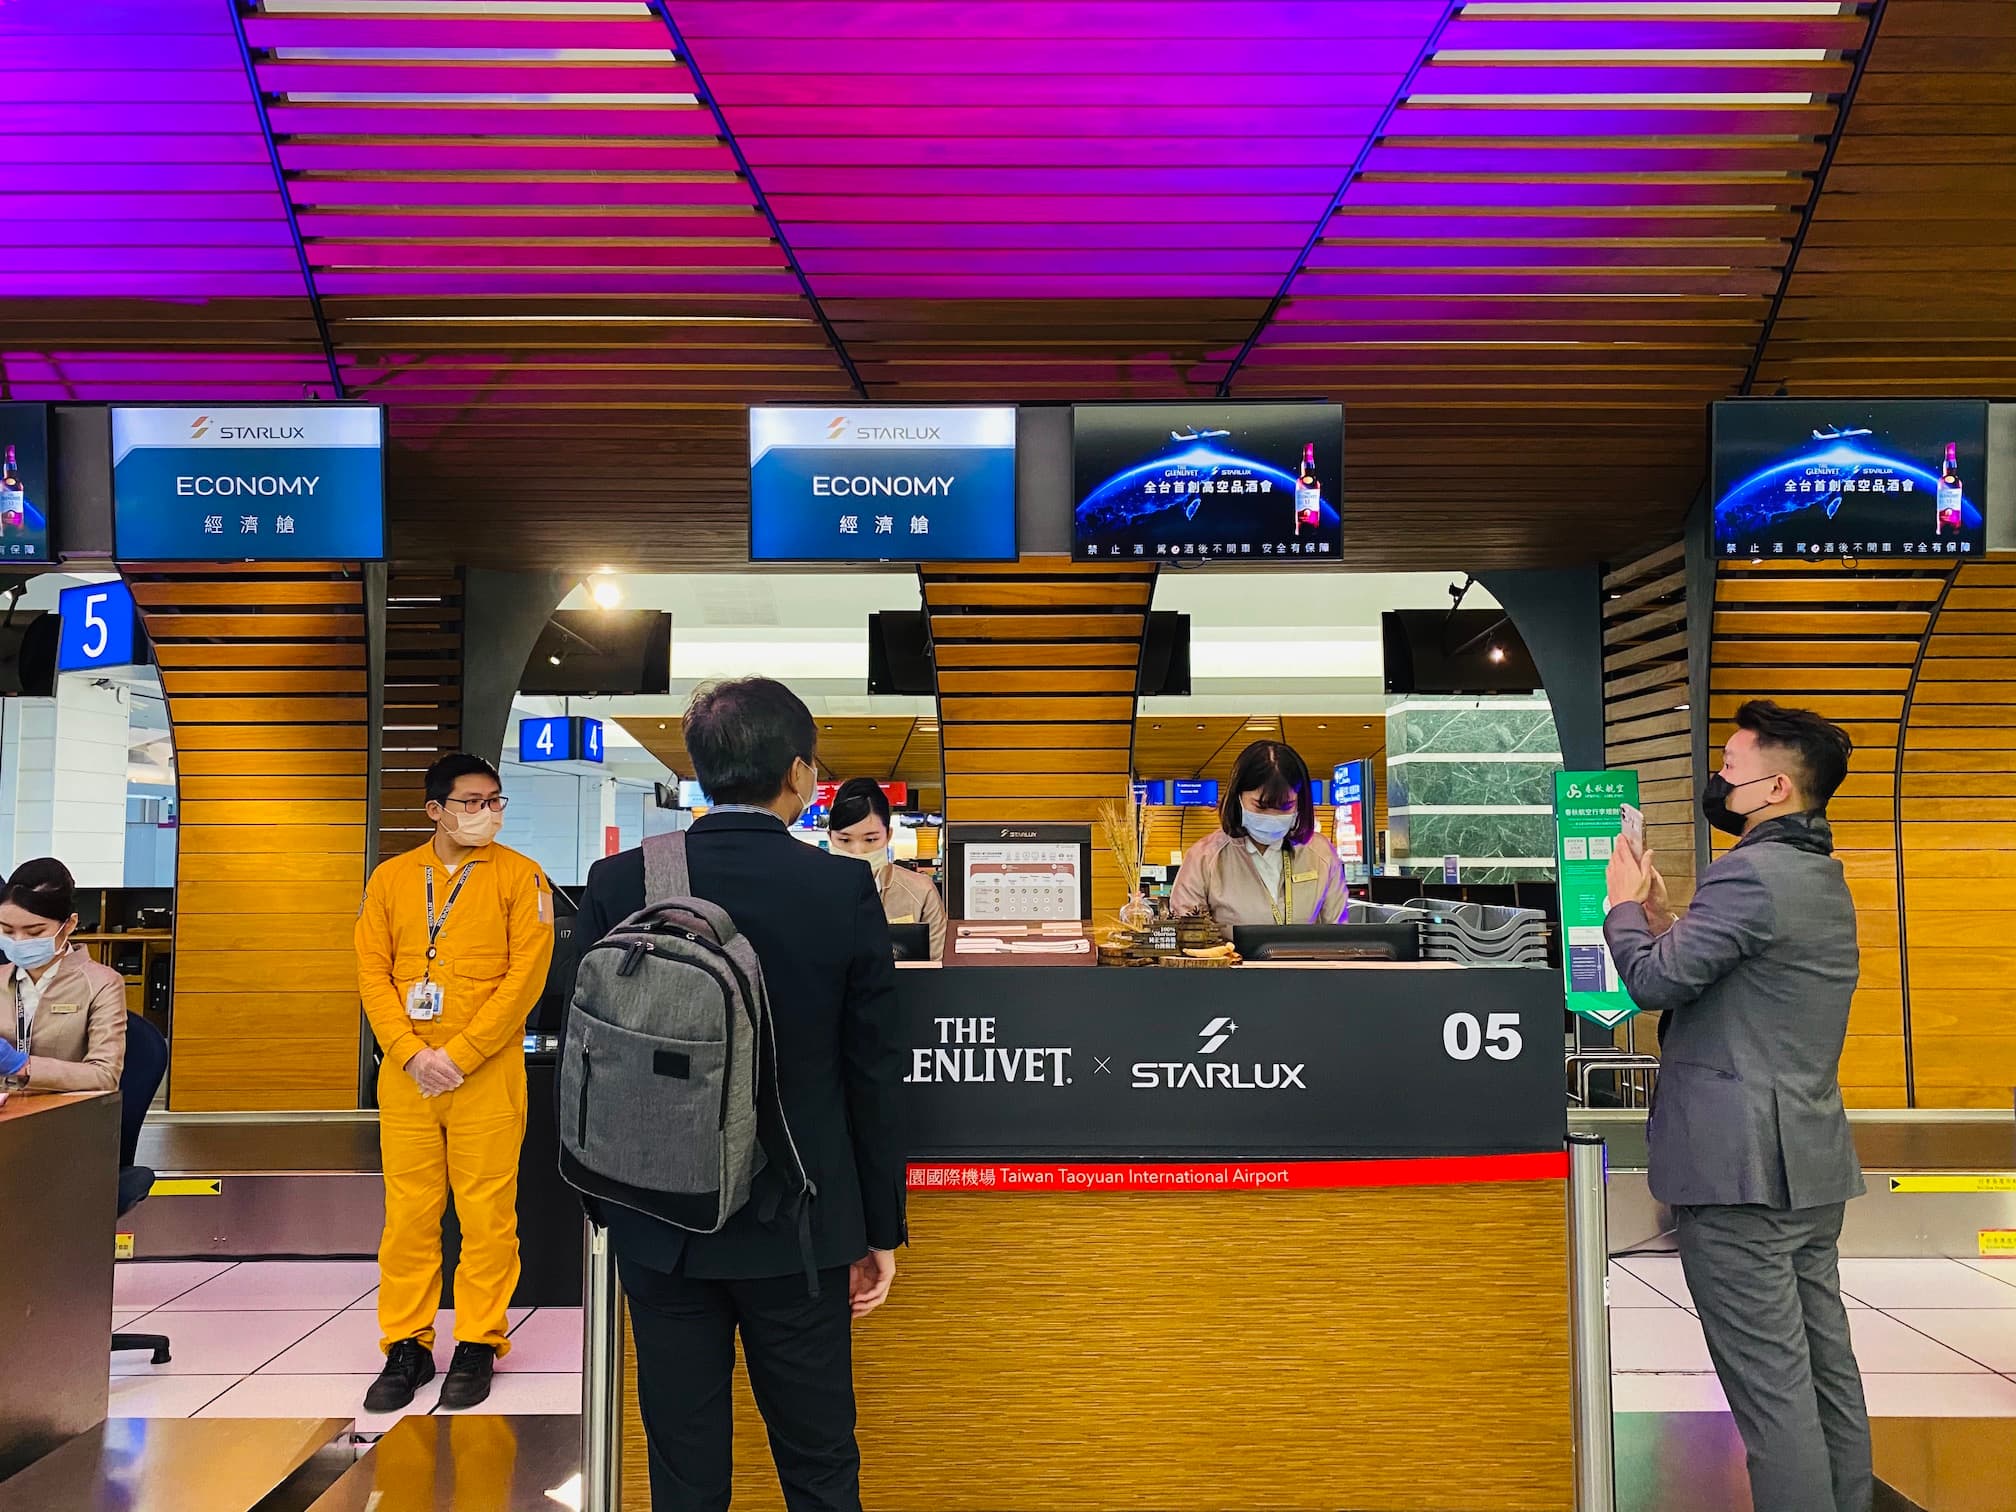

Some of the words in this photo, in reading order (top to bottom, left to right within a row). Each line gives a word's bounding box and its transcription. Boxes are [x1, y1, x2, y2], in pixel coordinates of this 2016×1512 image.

[220, 427, 304, 439] STARLUX
[857, 427, 940, 440] STARLUX
[176, 476, 320, 495] ECONOMY
[813, 476, 955, 496] ECONOMY
[1144, 480, 1272, 494] 全台首創高空品酒會
[1784, 479, 1914, 492] 全台首創高空品酒會
[204, 515, 295, 534] 經濟艙
[839, 515, 929, 534] 經濟艙
[82, 593, 108, 658] 5
[536, 723, 554, 755] 4
[589, 725, 598, 756] 4
[934, 1017, 996, 1044] THE
[1443, 1012, 1523, 1061] 05
[903, 1048, 1073, 1087] ENLIVET.
[1131, 1063, 1306, 1089] STARLUX
[906, 1168, 995, 1186] 園國際機場
[1000, 1168, 1054, 1183] Taiwan
[1058, 1168, 1124, 1188] Taoyuan
[1129, 1168, 1228, 1184] International
[1232, 1168, 1289, 1186] Airport
